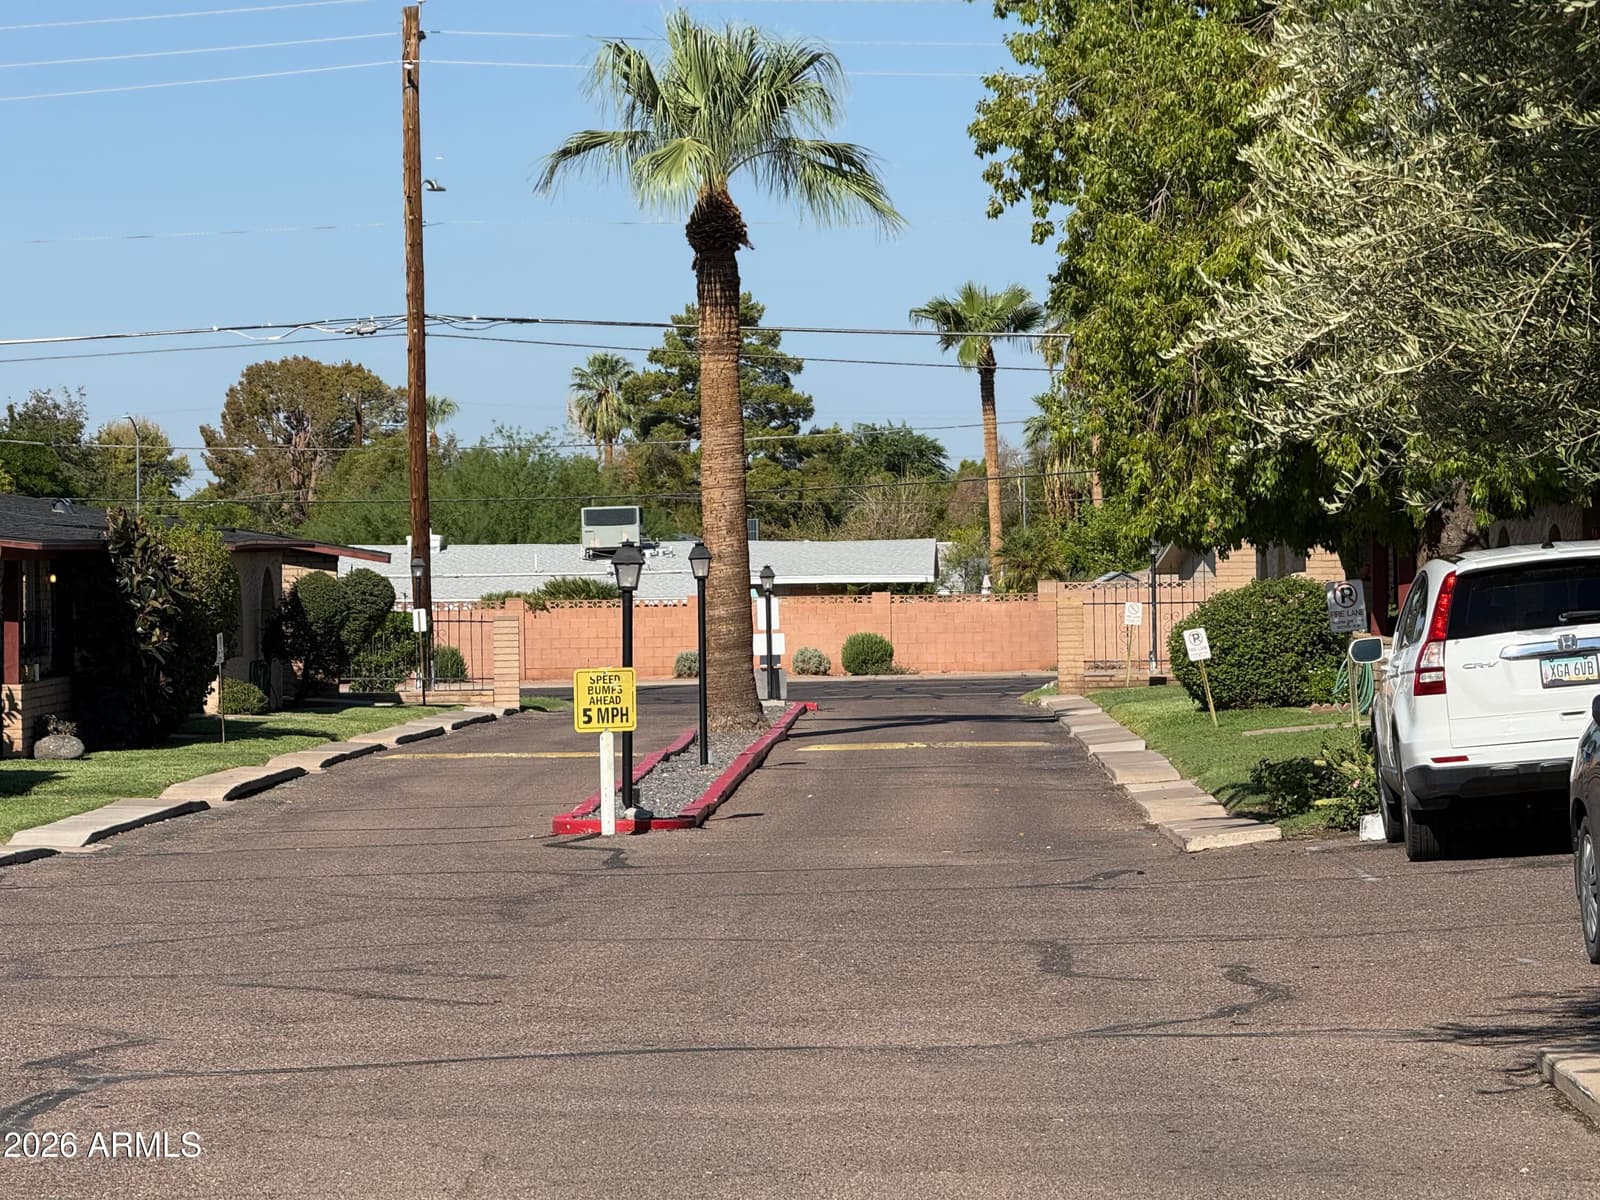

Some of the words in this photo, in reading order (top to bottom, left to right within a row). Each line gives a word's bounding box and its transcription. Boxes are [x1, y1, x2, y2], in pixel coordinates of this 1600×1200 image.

[1550, 663, 1570, 678] XGA
[589, 675, 621, 684] SPEED
[587, 685, 623, 695] BUMPS
[589, 695, 622, 705] AHEAD
[582, 708, 593, 724] 5
[597, 707, 629, 723] MPH
